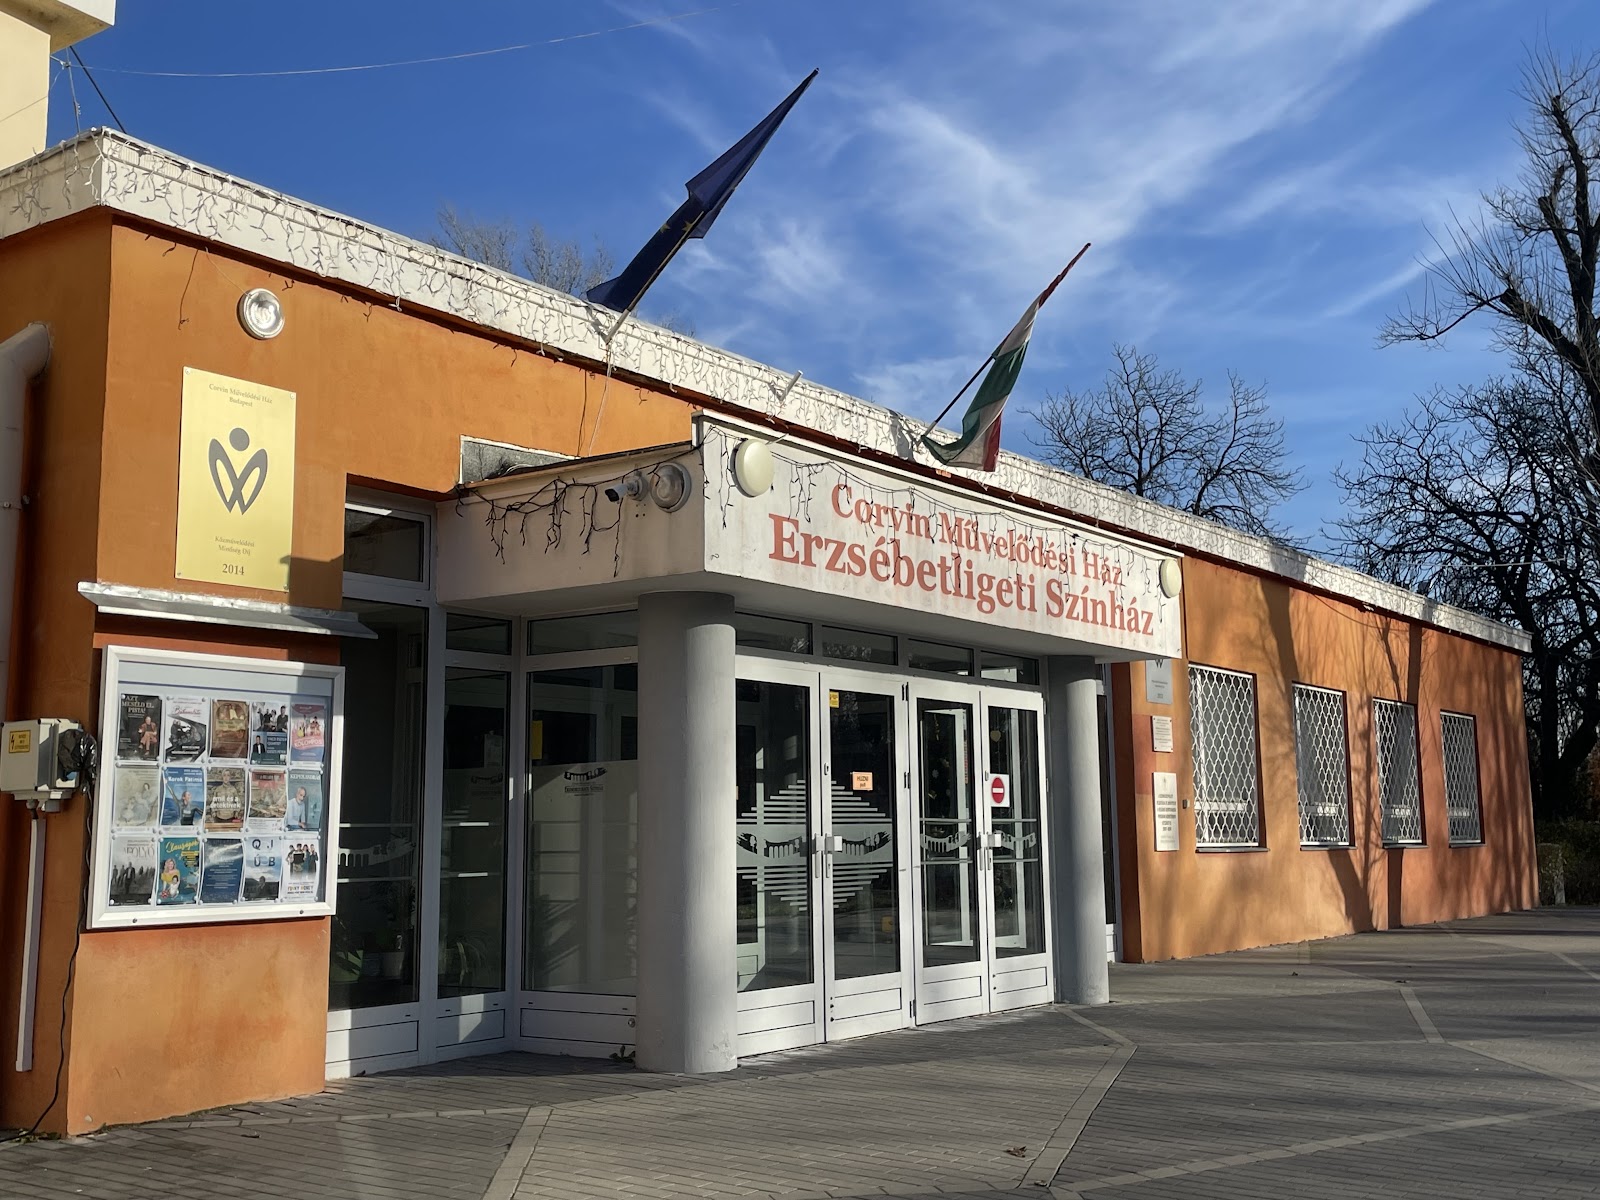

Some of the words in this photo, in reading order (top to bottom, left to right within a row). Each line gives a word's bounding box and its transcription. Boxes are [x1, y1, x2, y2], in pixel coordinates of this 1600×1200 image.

[208, 383, 229, 394] Corvin
[229, 396, 253, 407] Budapest
[831, 483, 931, 540] Corvin
[938, 510, 1077, 576] Művelődési
[1082, 550, 1123, 587] Ház
[222, 563, 245, 576] 2014
[768, 513, 1037, 615] Erzsébetligeti
[1046, 578, 1154, 636] Színház
